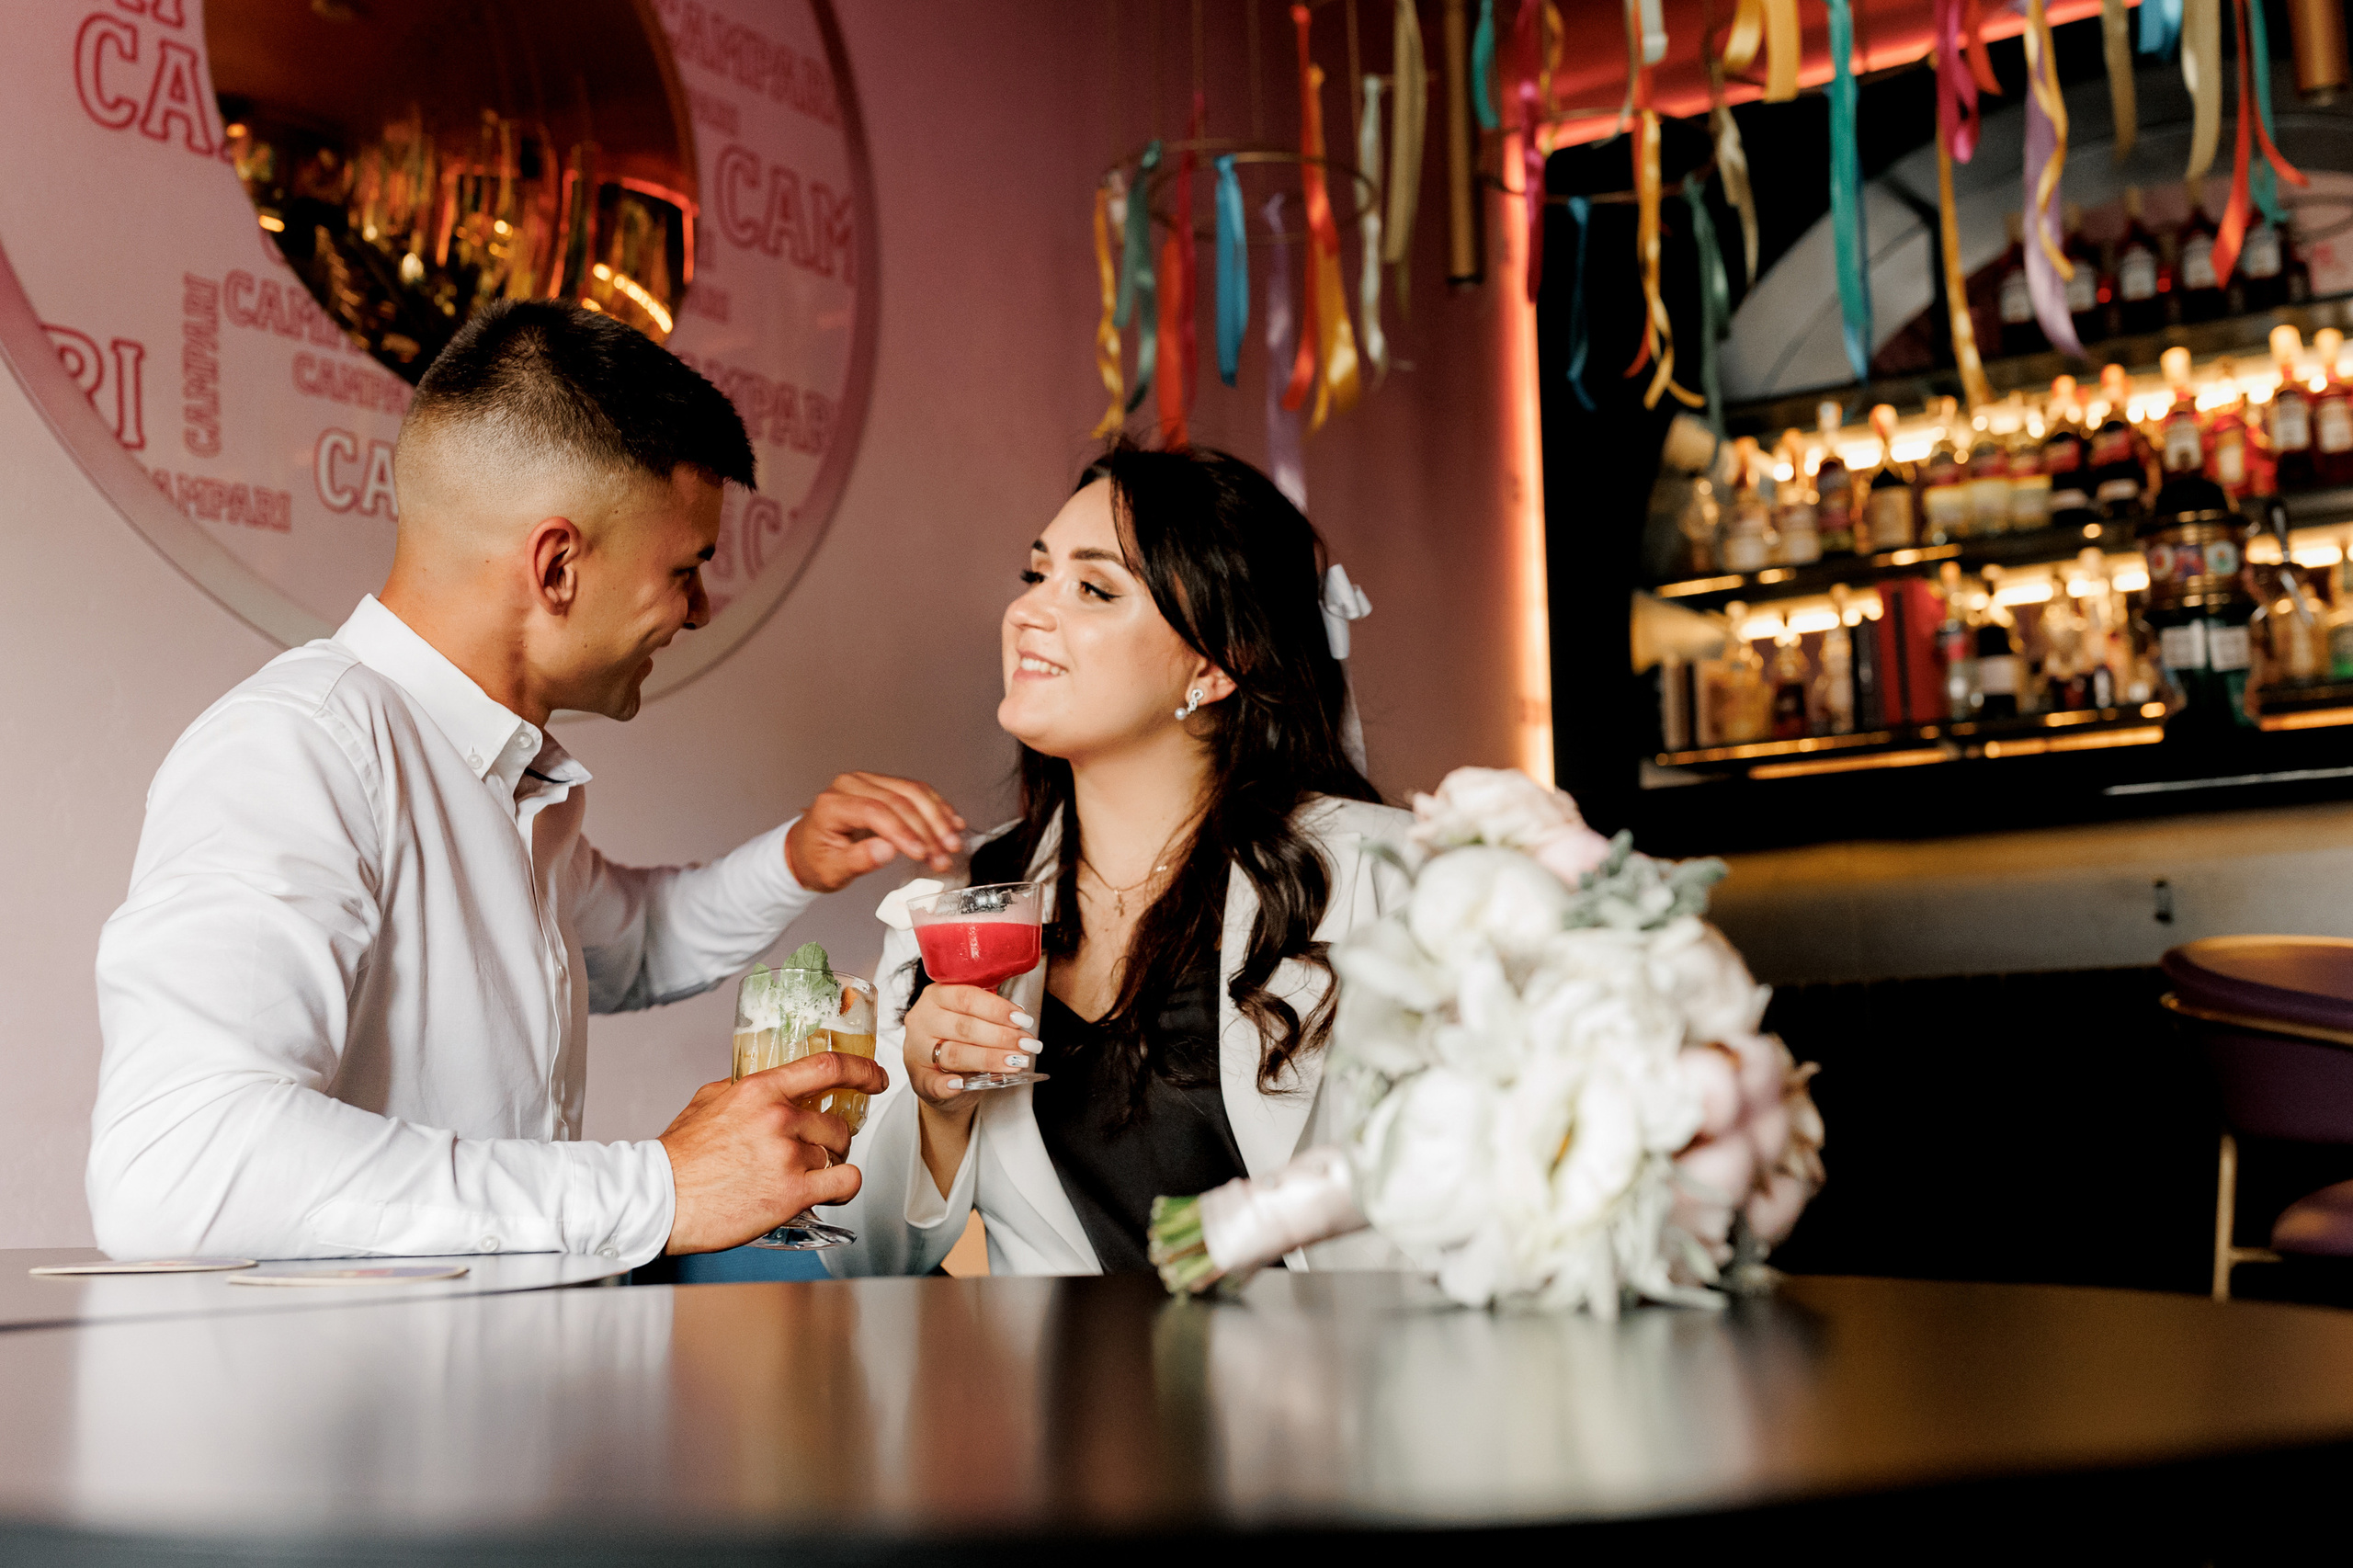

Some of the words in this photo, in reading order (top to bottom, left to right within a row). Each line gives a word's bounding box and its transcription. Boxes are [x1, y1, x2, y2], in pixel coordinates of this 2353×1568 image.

[74, 12, 235, 164] CA
[182, 271, 222, 458] CAMPARI
[142, 462, 292, 532] AMPARI
